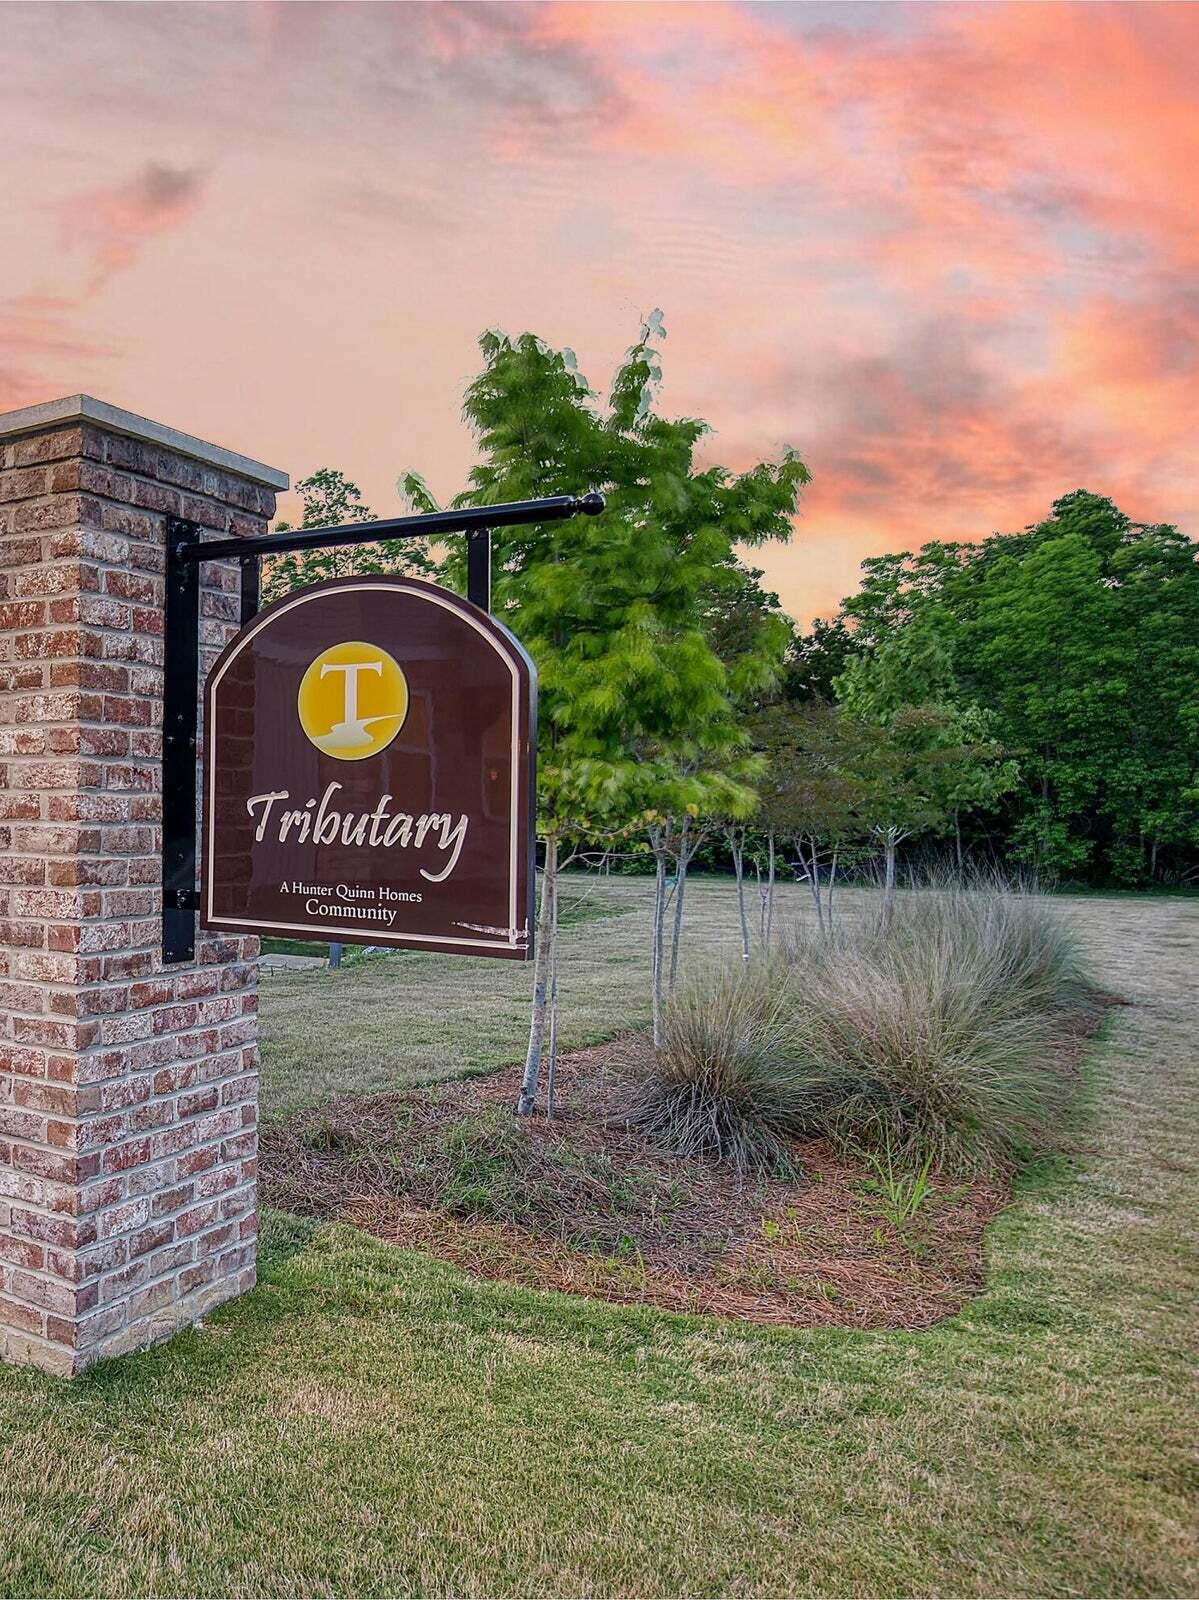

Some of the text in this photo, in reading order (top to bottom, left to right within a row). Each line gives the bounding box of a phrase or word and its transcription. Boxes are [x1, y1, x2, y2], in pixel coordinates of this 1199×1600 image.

[246, 781, 469, 882] Tributary
[280, 881, 423, 903] A Hunter Quinn Homes
[305, 898, 397, 926] Community
